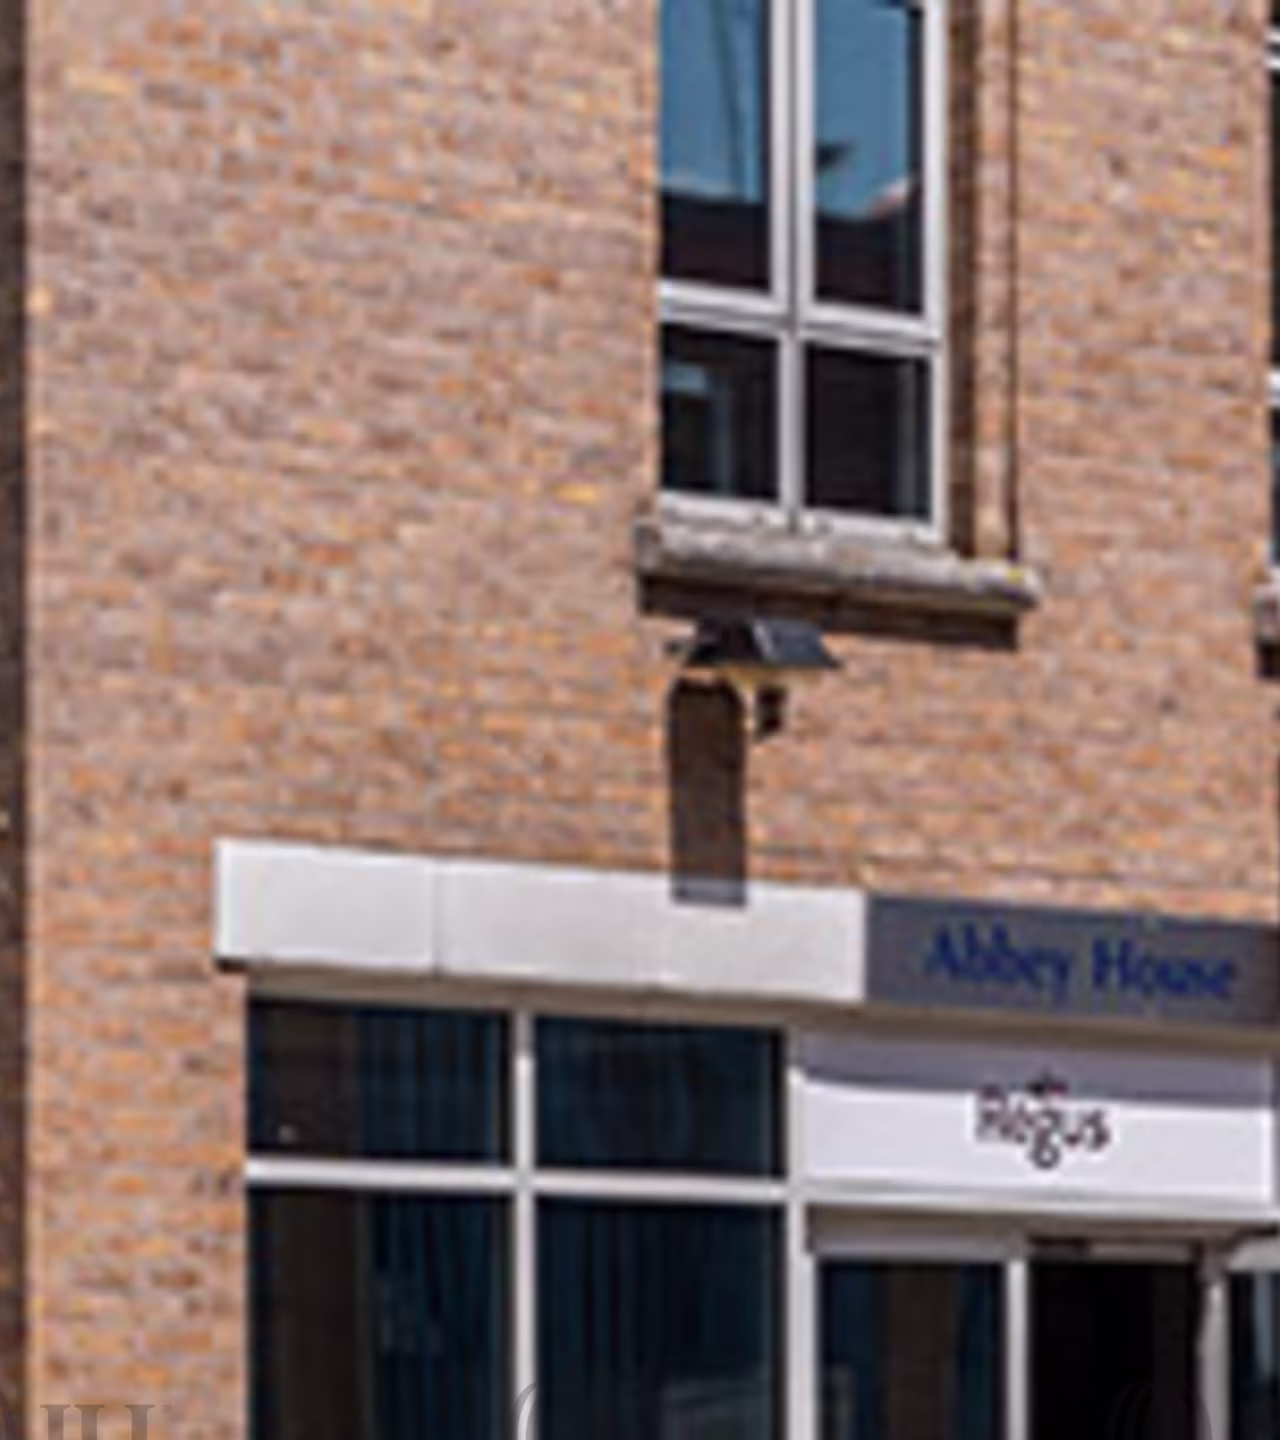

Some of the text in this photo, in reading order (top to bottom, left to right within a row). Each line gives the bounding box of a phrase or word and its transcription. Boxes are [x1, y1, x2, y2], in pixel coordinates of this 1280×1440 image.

[924, 921, 1237, 1004] Abbey House
[974, 1082, 1112, 1170] Regus
